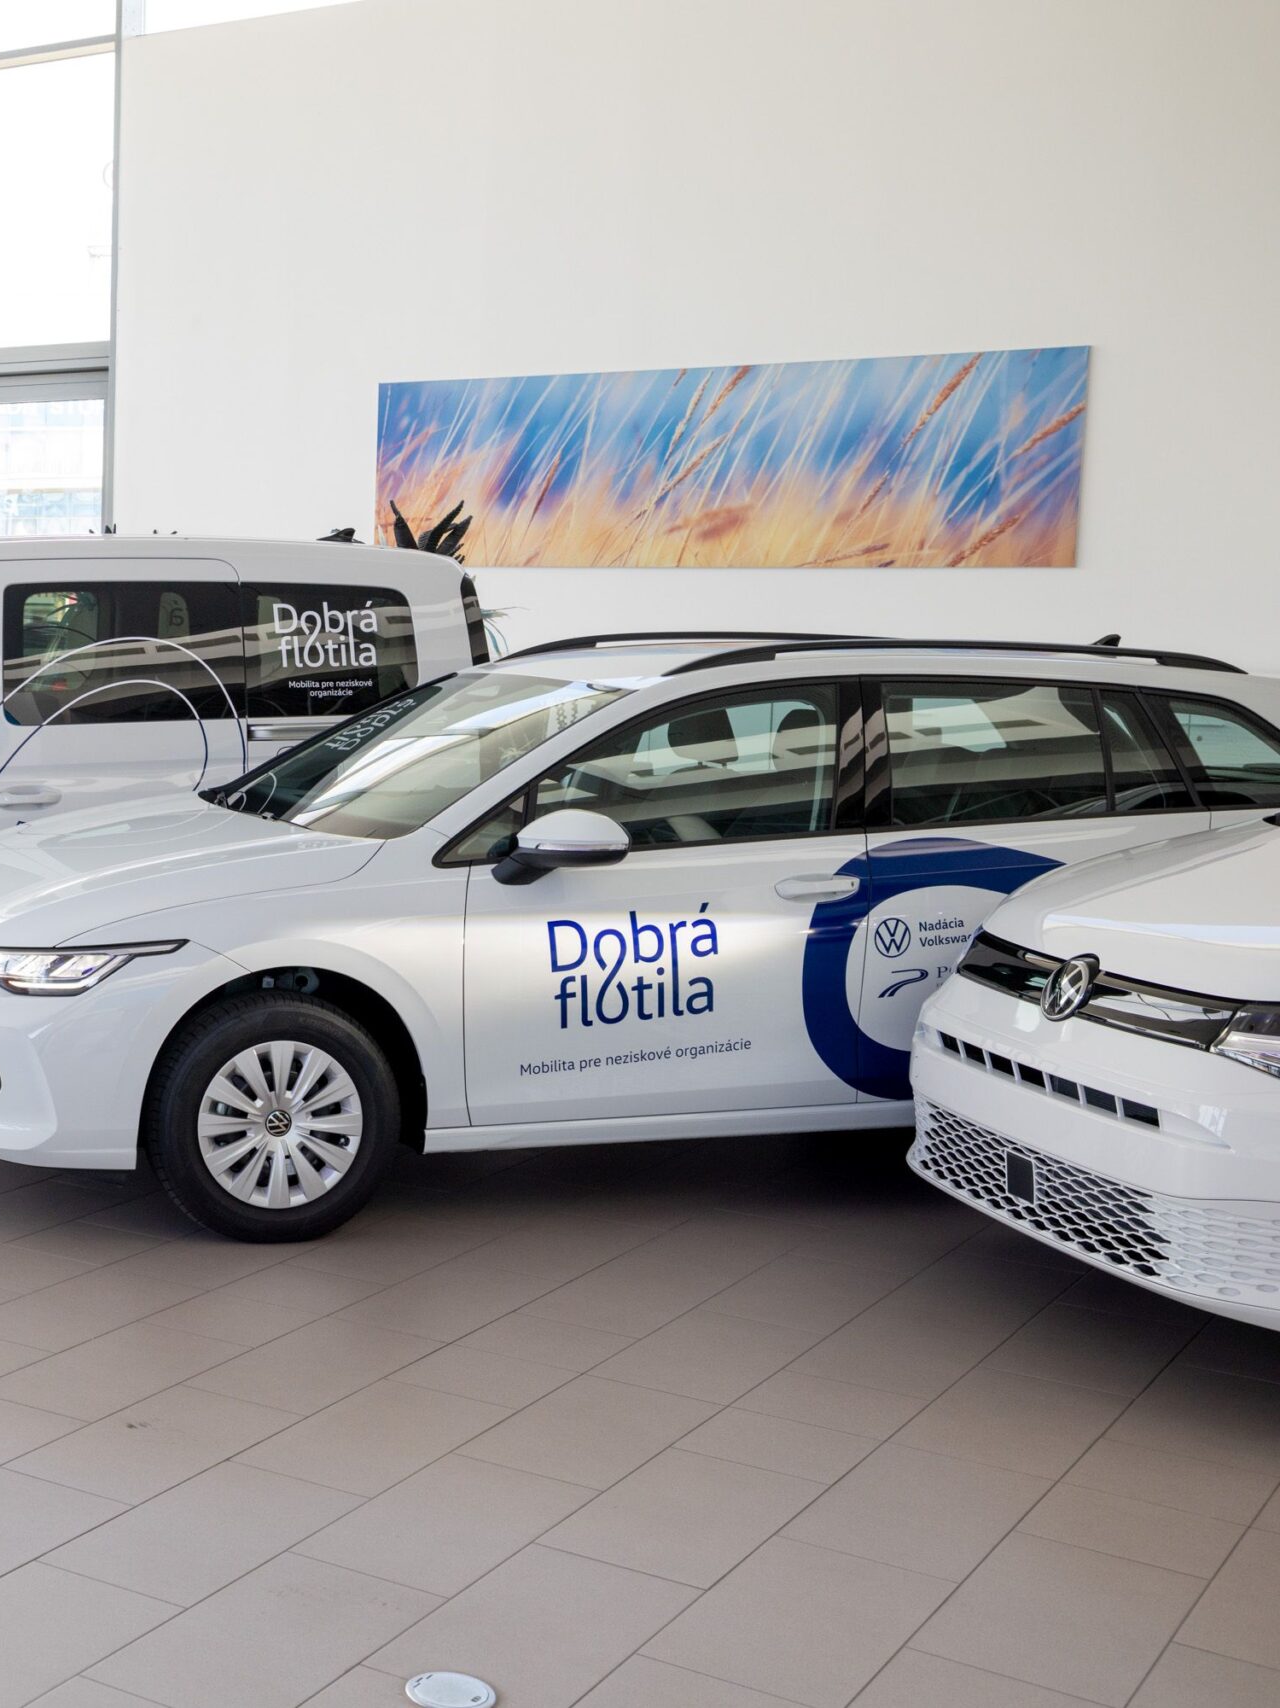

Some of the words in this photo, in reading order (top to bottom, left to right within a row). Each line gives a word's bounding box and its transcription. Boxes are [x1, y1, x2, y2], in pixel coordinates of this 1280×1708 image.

[273, 601, 378, 634] Dobrá
[278, 634, 377, 668] flotila
[288, 680, 320, 689] Mobilita
[321, 681, 334, 690] pre
[335, 678, 373, 688] neziskové
[309, 688, 353, 698] organizácie
[547, 902, 719, 973] Dobrá
[918, 917, 965, 932] Nadácia
[919, 933, 972, 947] Volkswa
[554, 966, 714, 1029] flotila
[520, 1056, 575, 1076] Mobilita
[578, 1054, 602, 1072] pre
[605, 1046, 671, 1066] neziskové
[675, 1038, 752, 1060] organizácie
